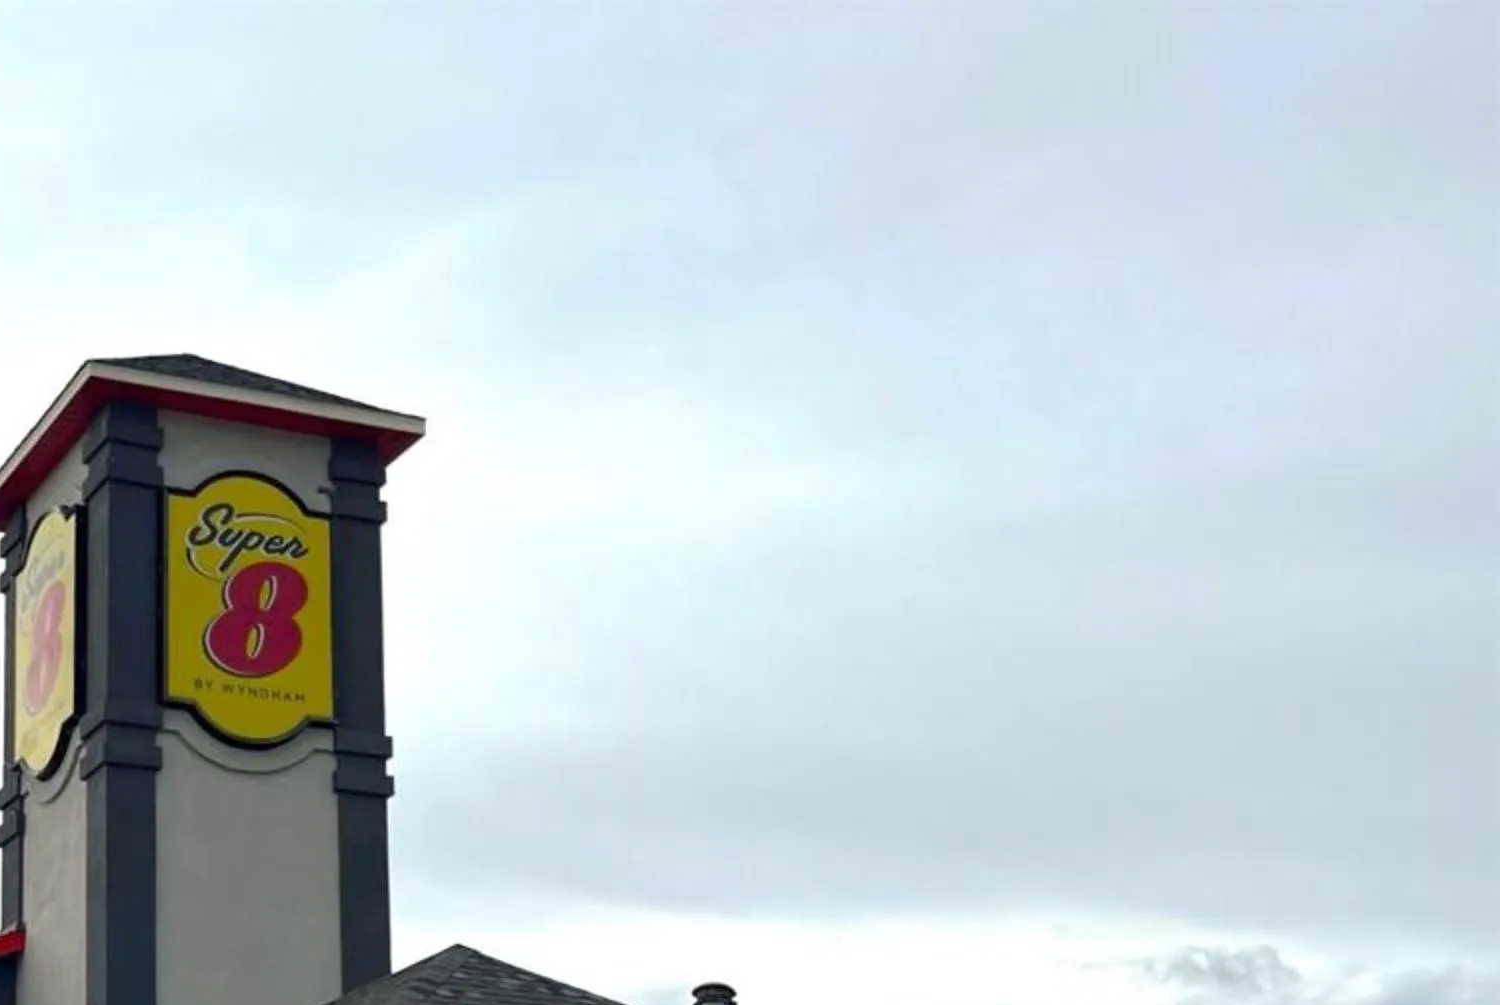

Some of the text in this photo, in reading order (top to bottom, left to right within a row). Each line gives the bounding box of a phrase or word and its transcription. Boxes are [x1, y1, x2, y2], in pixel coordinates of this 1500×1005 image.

[189, 503, 308, 572] Super
[203, 561, 309, 678] 8
[194, 677, 306, 702] BY WYNDHAM
